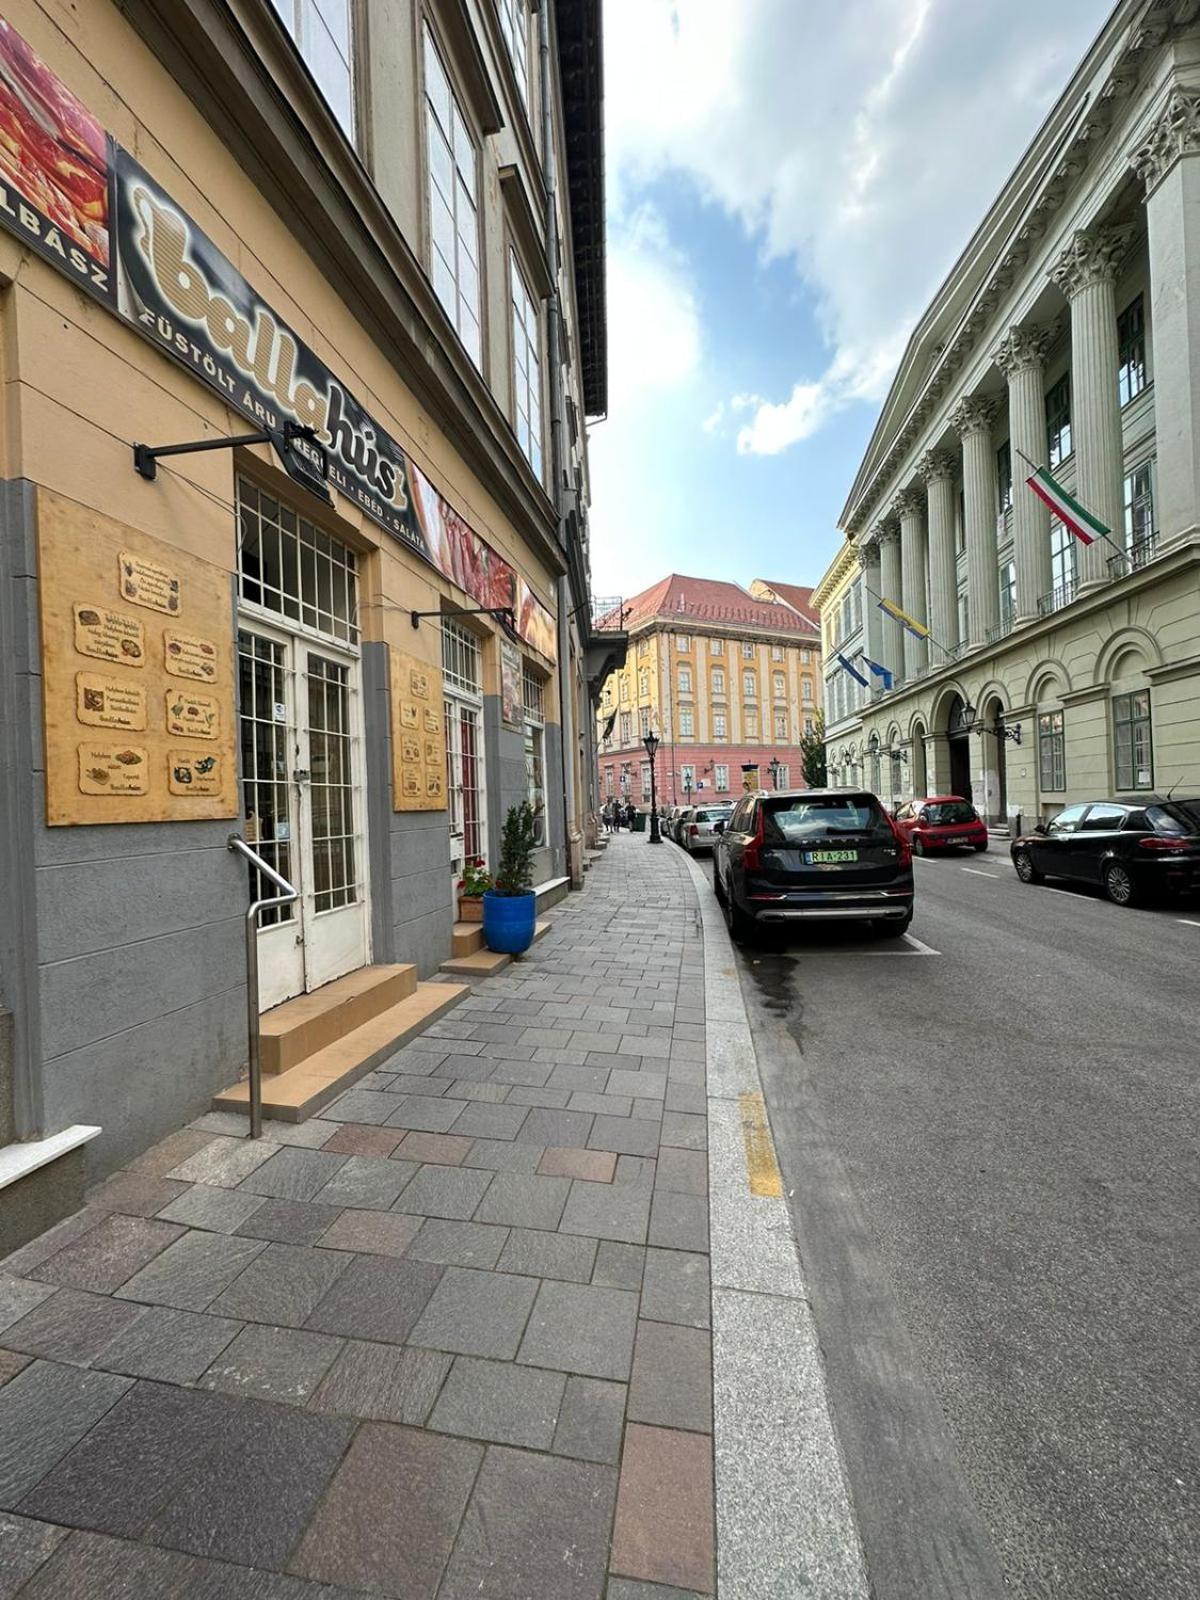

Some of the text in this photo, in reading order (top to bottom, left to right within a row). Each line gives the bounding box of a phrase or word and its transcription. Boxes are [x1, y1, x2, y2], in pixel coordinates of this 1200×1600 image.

[138, 307, 236, 393] FÜSTÖLT
[243, 390, 276, 428] ÁRU
[358, 489, 383, 516] EBÉD
[811, 851, 856, 861] RIA-231
